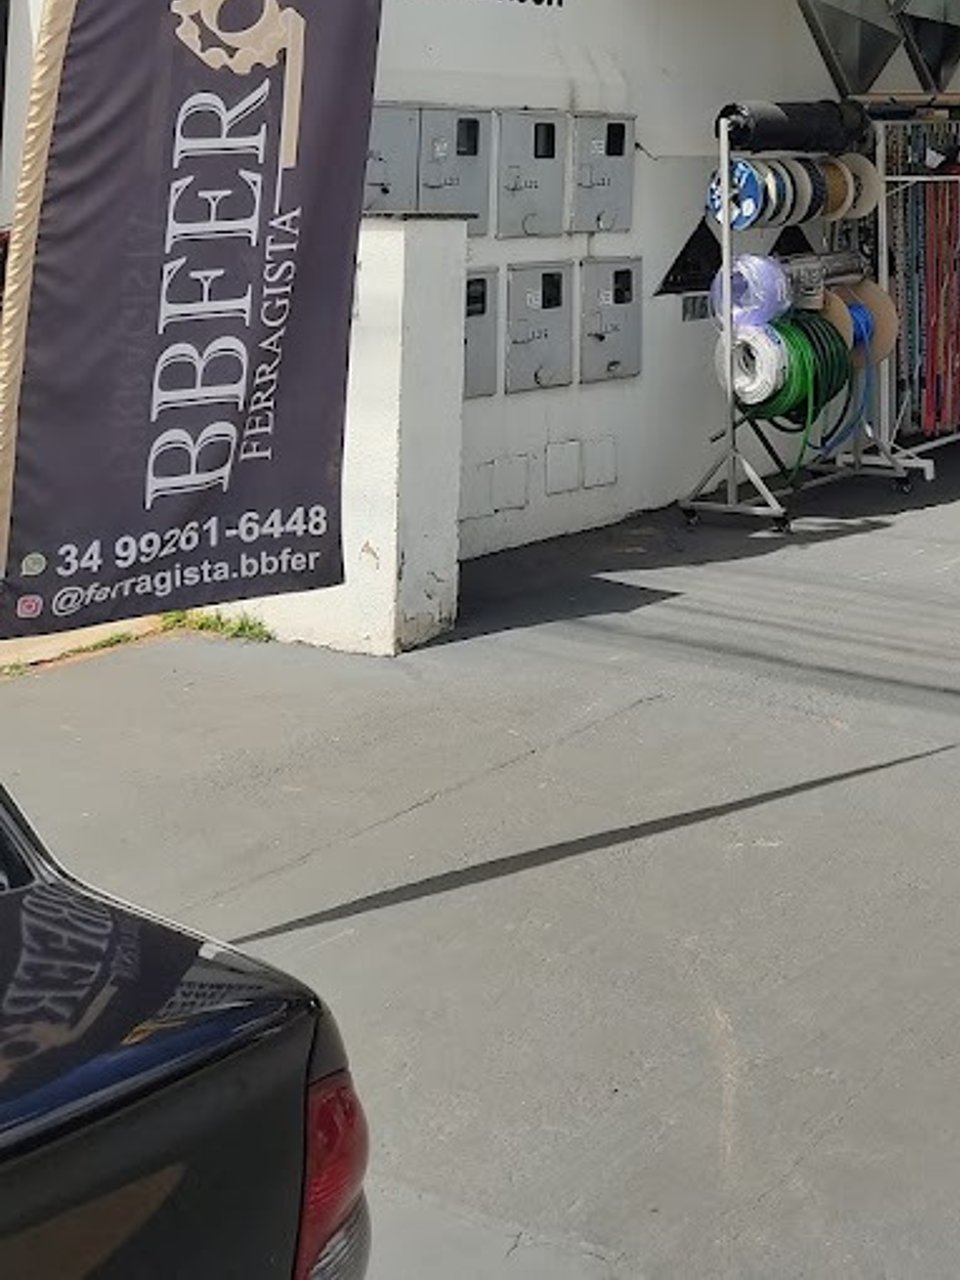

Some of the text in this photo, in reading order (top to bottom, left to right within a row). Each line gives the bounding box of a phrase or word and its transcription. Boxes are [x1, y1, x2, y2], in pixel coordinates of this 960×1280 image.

[144, 76, 272, 510] BBFER
[238, 204, 302, 462] FERRAGISTA
[51, 547, 321, 616] @ferragista.bbfer
[56, 505, 328, 576] 34 99261-6448
